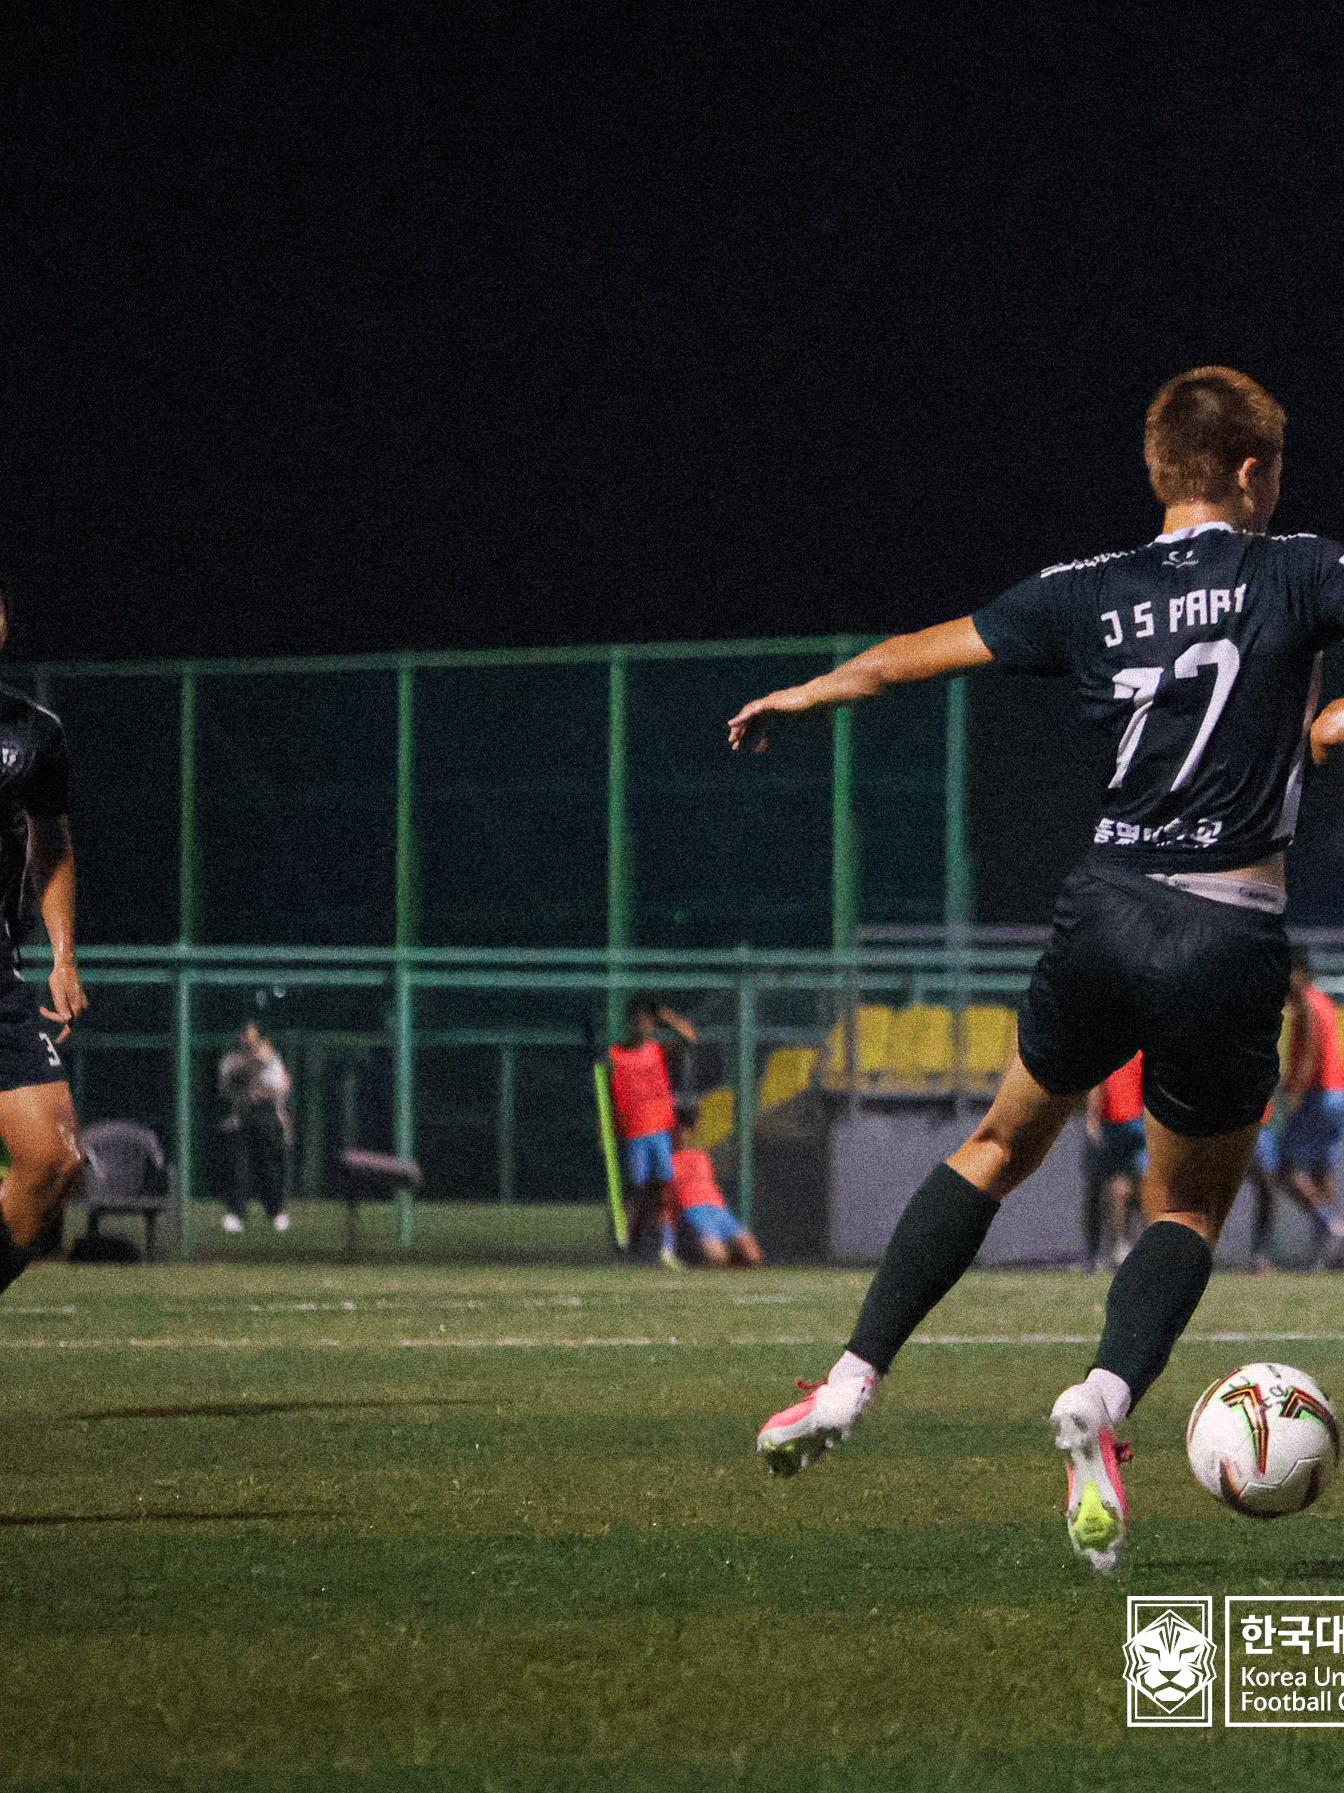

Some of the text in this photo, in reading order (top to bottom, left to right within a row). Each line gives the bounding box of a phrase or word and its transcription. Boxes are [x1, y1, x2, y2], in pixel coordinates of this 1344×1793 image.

[1101, 610, 1124, 647] J
[1133, 600, 1155, 639] S
[1108, 638, 1241, 792] 77
